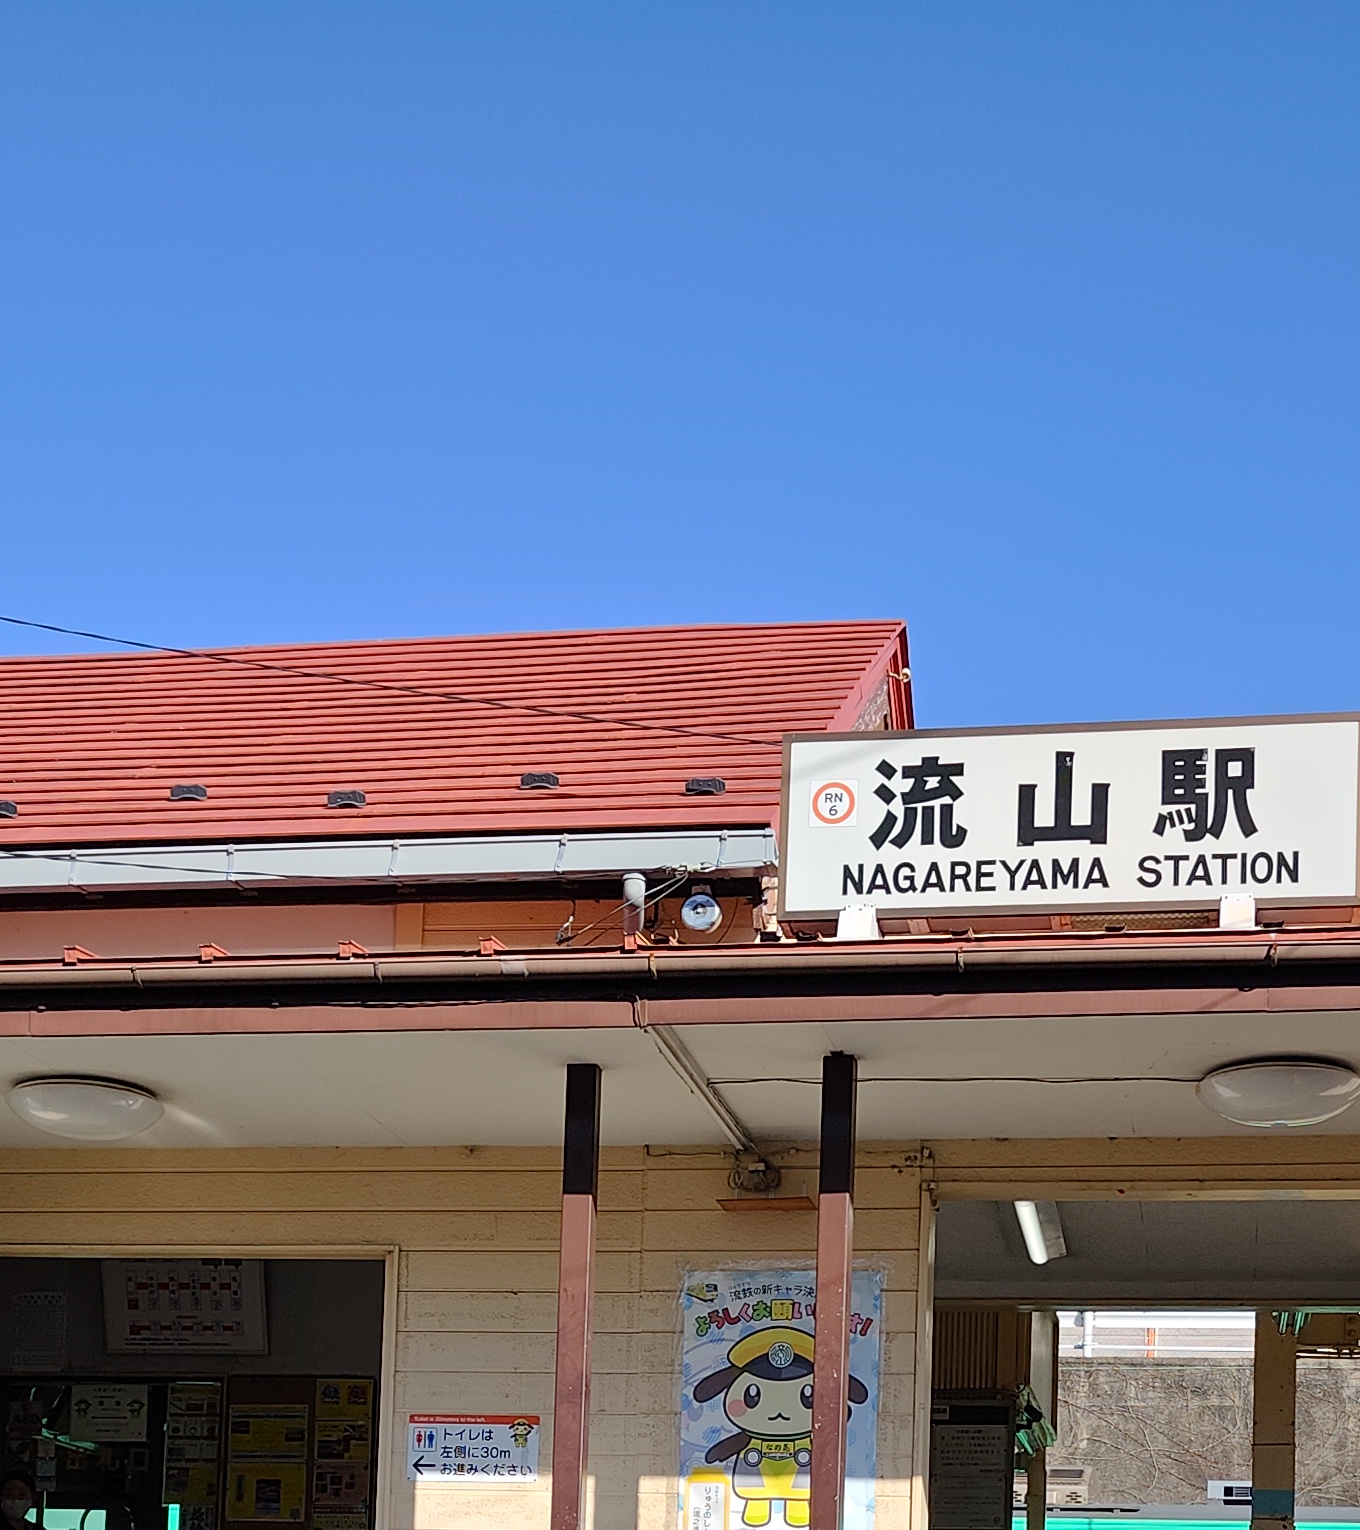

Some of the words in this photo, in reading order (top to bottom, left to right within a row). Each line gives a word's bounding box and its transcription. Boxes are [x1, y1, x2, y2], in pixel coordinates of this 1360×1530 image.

[824, 793, 843, 804] RN
[869, 746, 1258, 850] 流山駅
[828, 805, 838, 817] 6
[842, 857, 1108, 896] NAGAREYAMA
[1136, 851, 1300, 889] STATION
[729, 1283, 816, 1302] 流鉄の新キャラ決
[443, 1428, 493, 1441] トイレは
[440, 1445, 511, 1459] 左側に30m
[440, 1463, 532, 1476] お進みください
